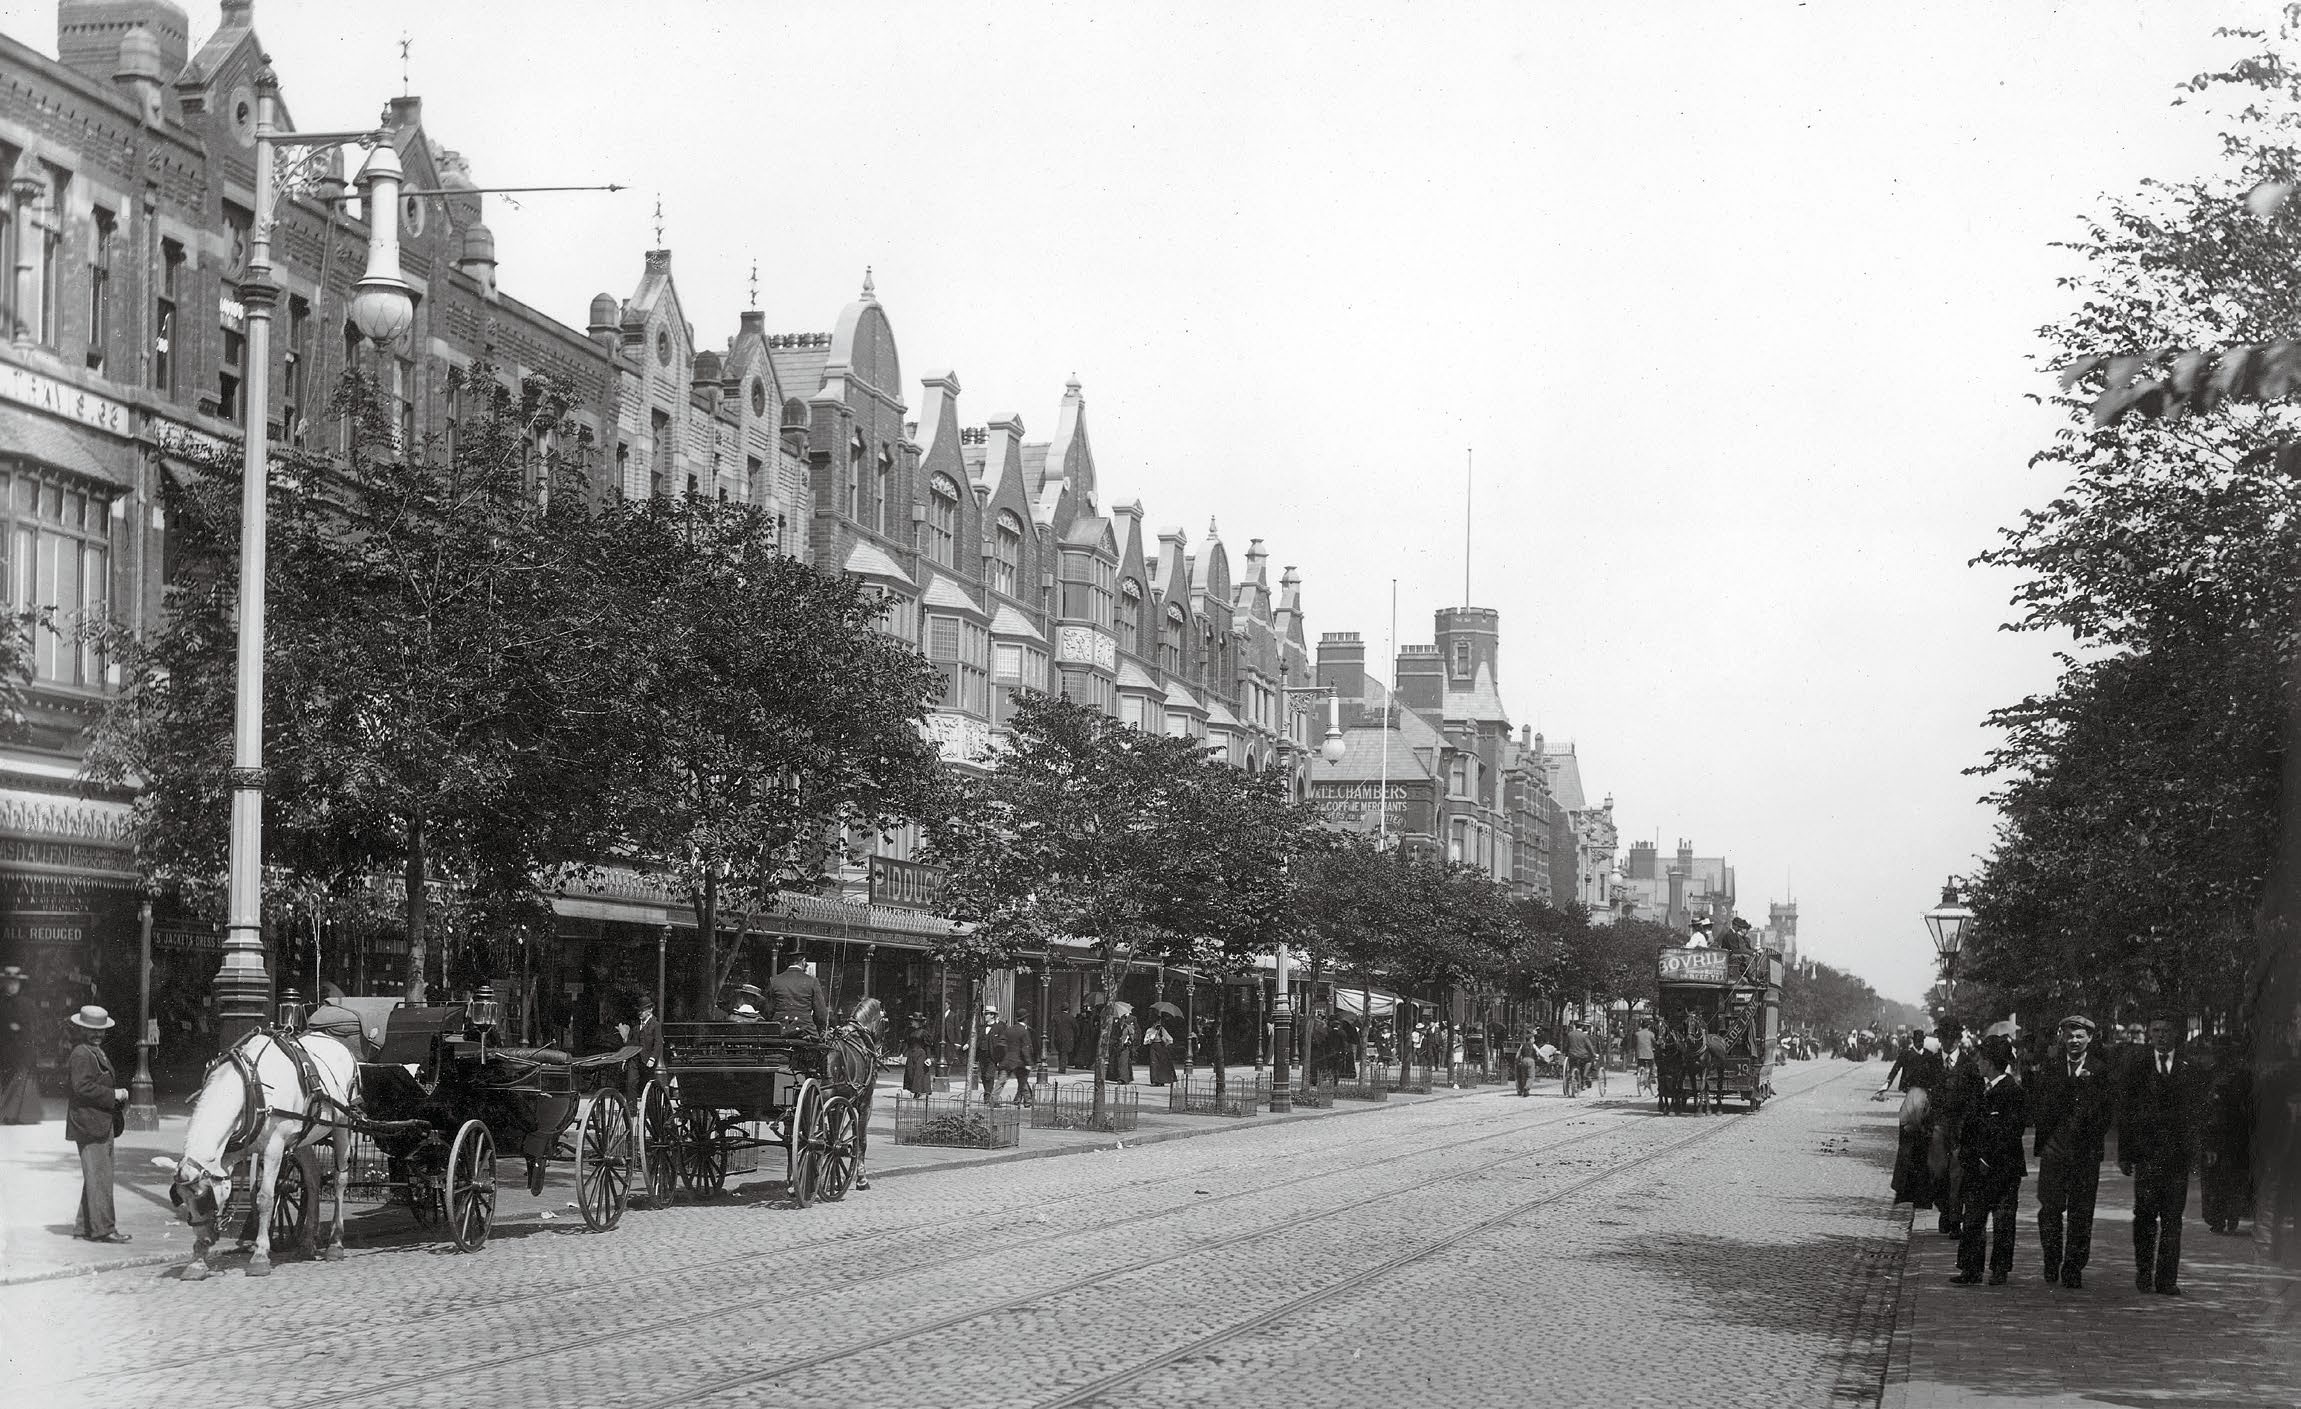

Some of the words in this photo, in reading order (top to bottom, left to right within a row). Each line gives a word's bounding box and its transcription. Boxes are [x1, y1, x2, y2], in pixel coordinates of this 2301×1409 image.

[1338, 784, 1408, 799] CHAMBERS
[875, 863, 943, 905] PIDDUCK
[30, 928, 82, 941] REDUCED
[1659, 952, 1726, 974] BOVRIL
